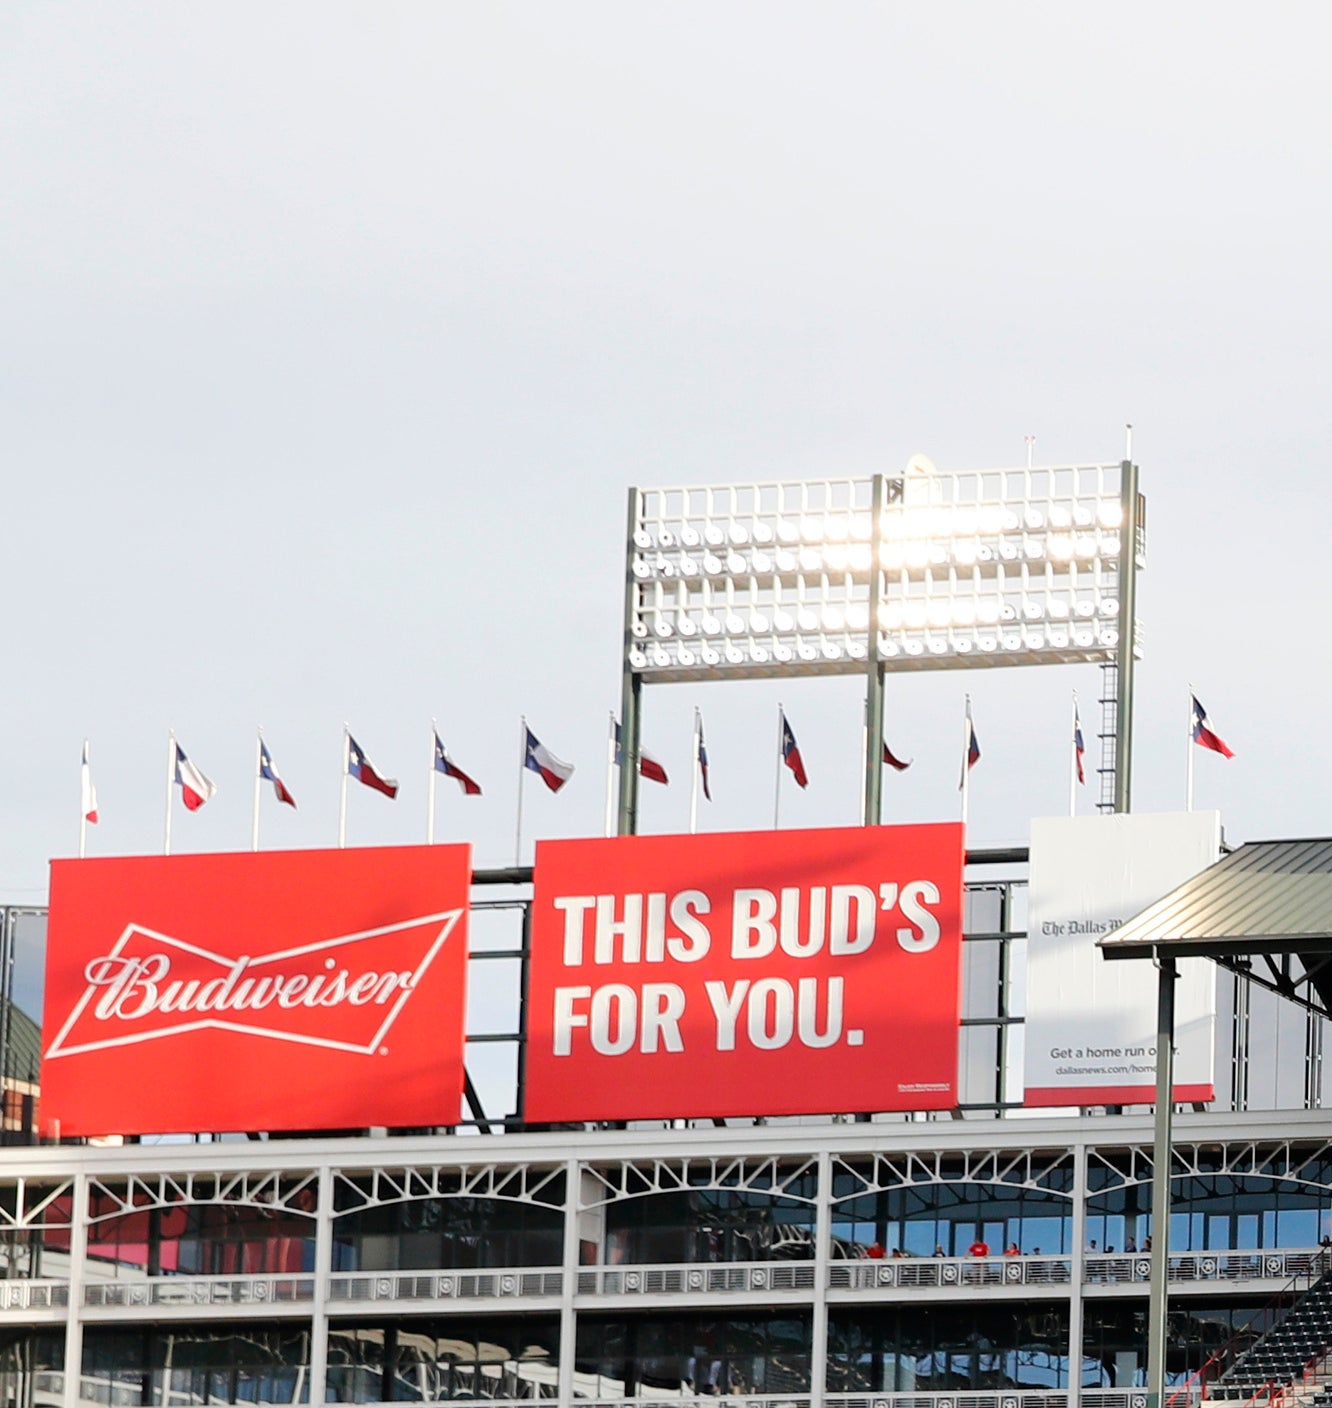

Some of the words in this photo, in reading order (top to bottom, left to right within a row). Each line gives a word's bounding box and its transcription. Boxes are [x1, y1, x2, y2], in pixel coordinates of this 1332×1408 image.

[553, 888, 712, 967] THIS
[730, 880, 942, 960] BUD'S
[1042, 921, 1065, 938] The
[1067, 919, 1107, 936] Dallas
[84, 953, 417, 1022] Budweiser
[552, 983, 686, 1058] FOR
[704, 976, 865, 1052] YOU.
[1051, 1047, 1074, 1060] Get
[1076, 1049, 1084, 1058] a
[1087, 1047, 1122, 1058] home
[1125, 1048, 1145, 1056] run
